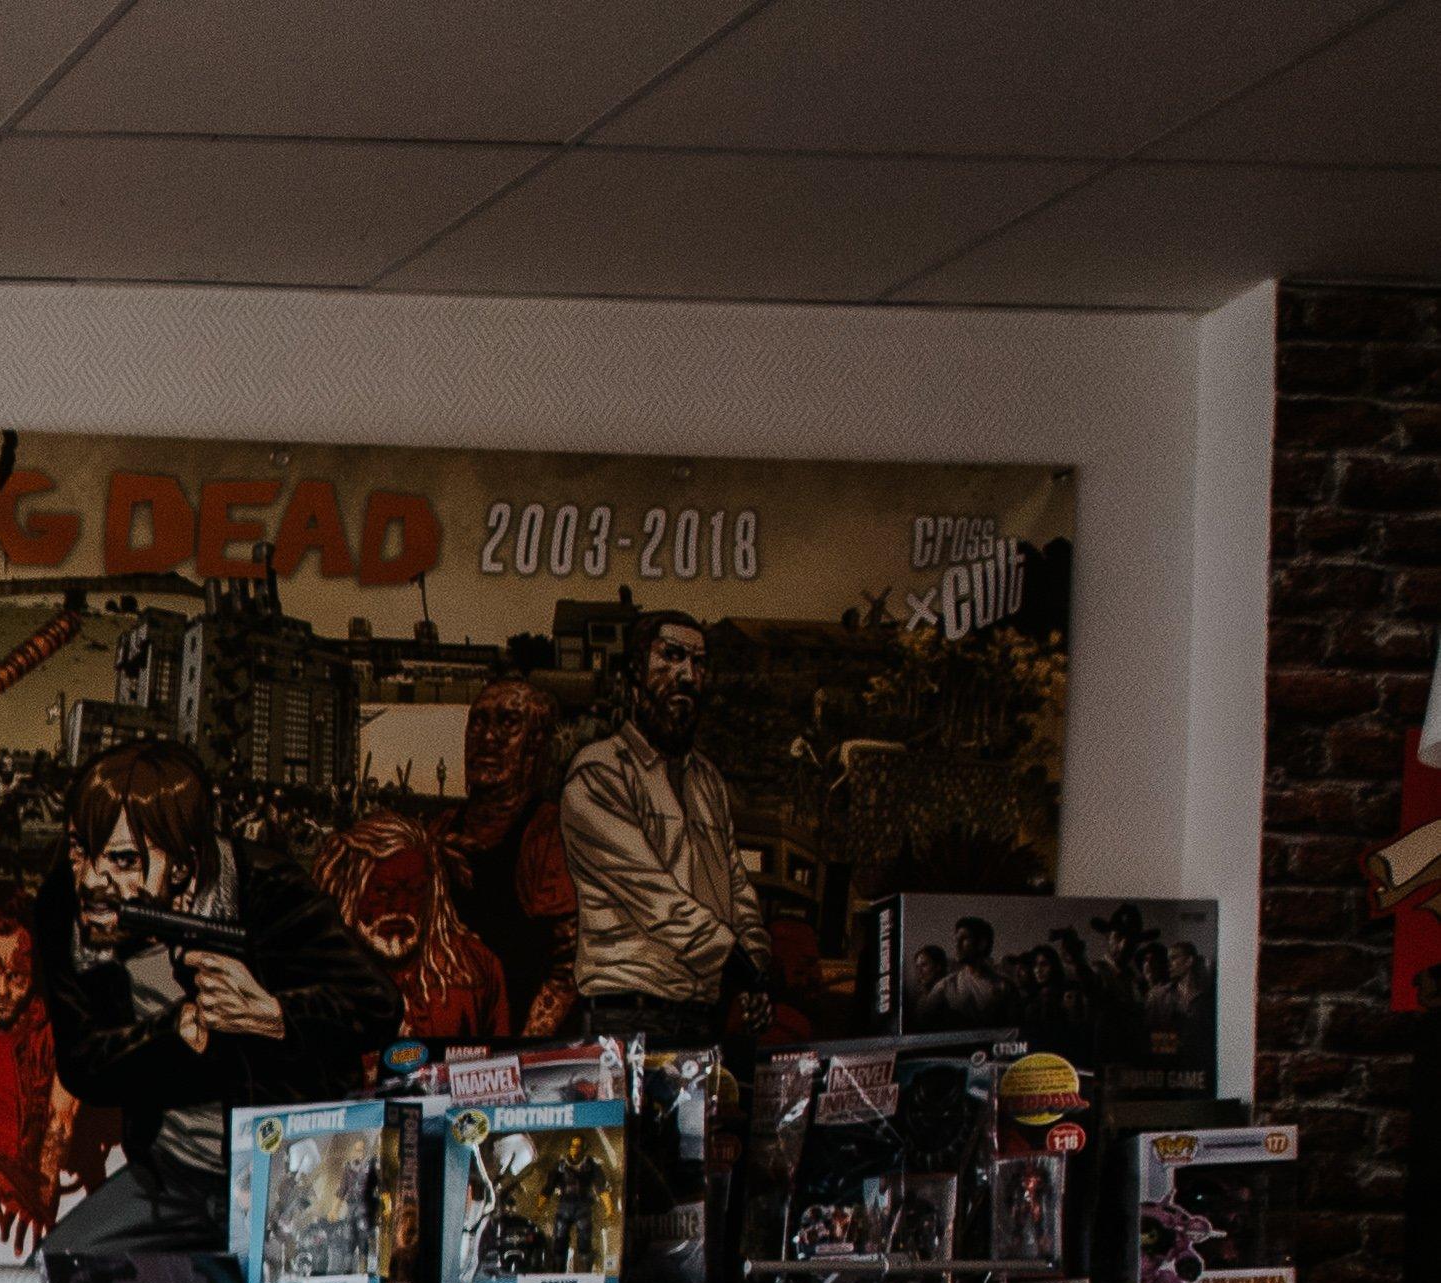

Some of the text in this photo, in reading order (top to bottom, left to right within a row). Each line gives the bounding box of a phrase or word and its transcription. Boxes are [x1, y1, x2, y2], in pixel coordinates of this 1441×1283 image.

[102, 470, 444, 588] DEAD
[481, 502, 757, 579] 2003-2018
[454, 1067, 517, 1097] MARVEL
[1165, 1069, 1207, 1090] GAME
[286, 1108, 345, 1132] FORTNITE
[494, 1105, 574, 1128] FORTNITE
